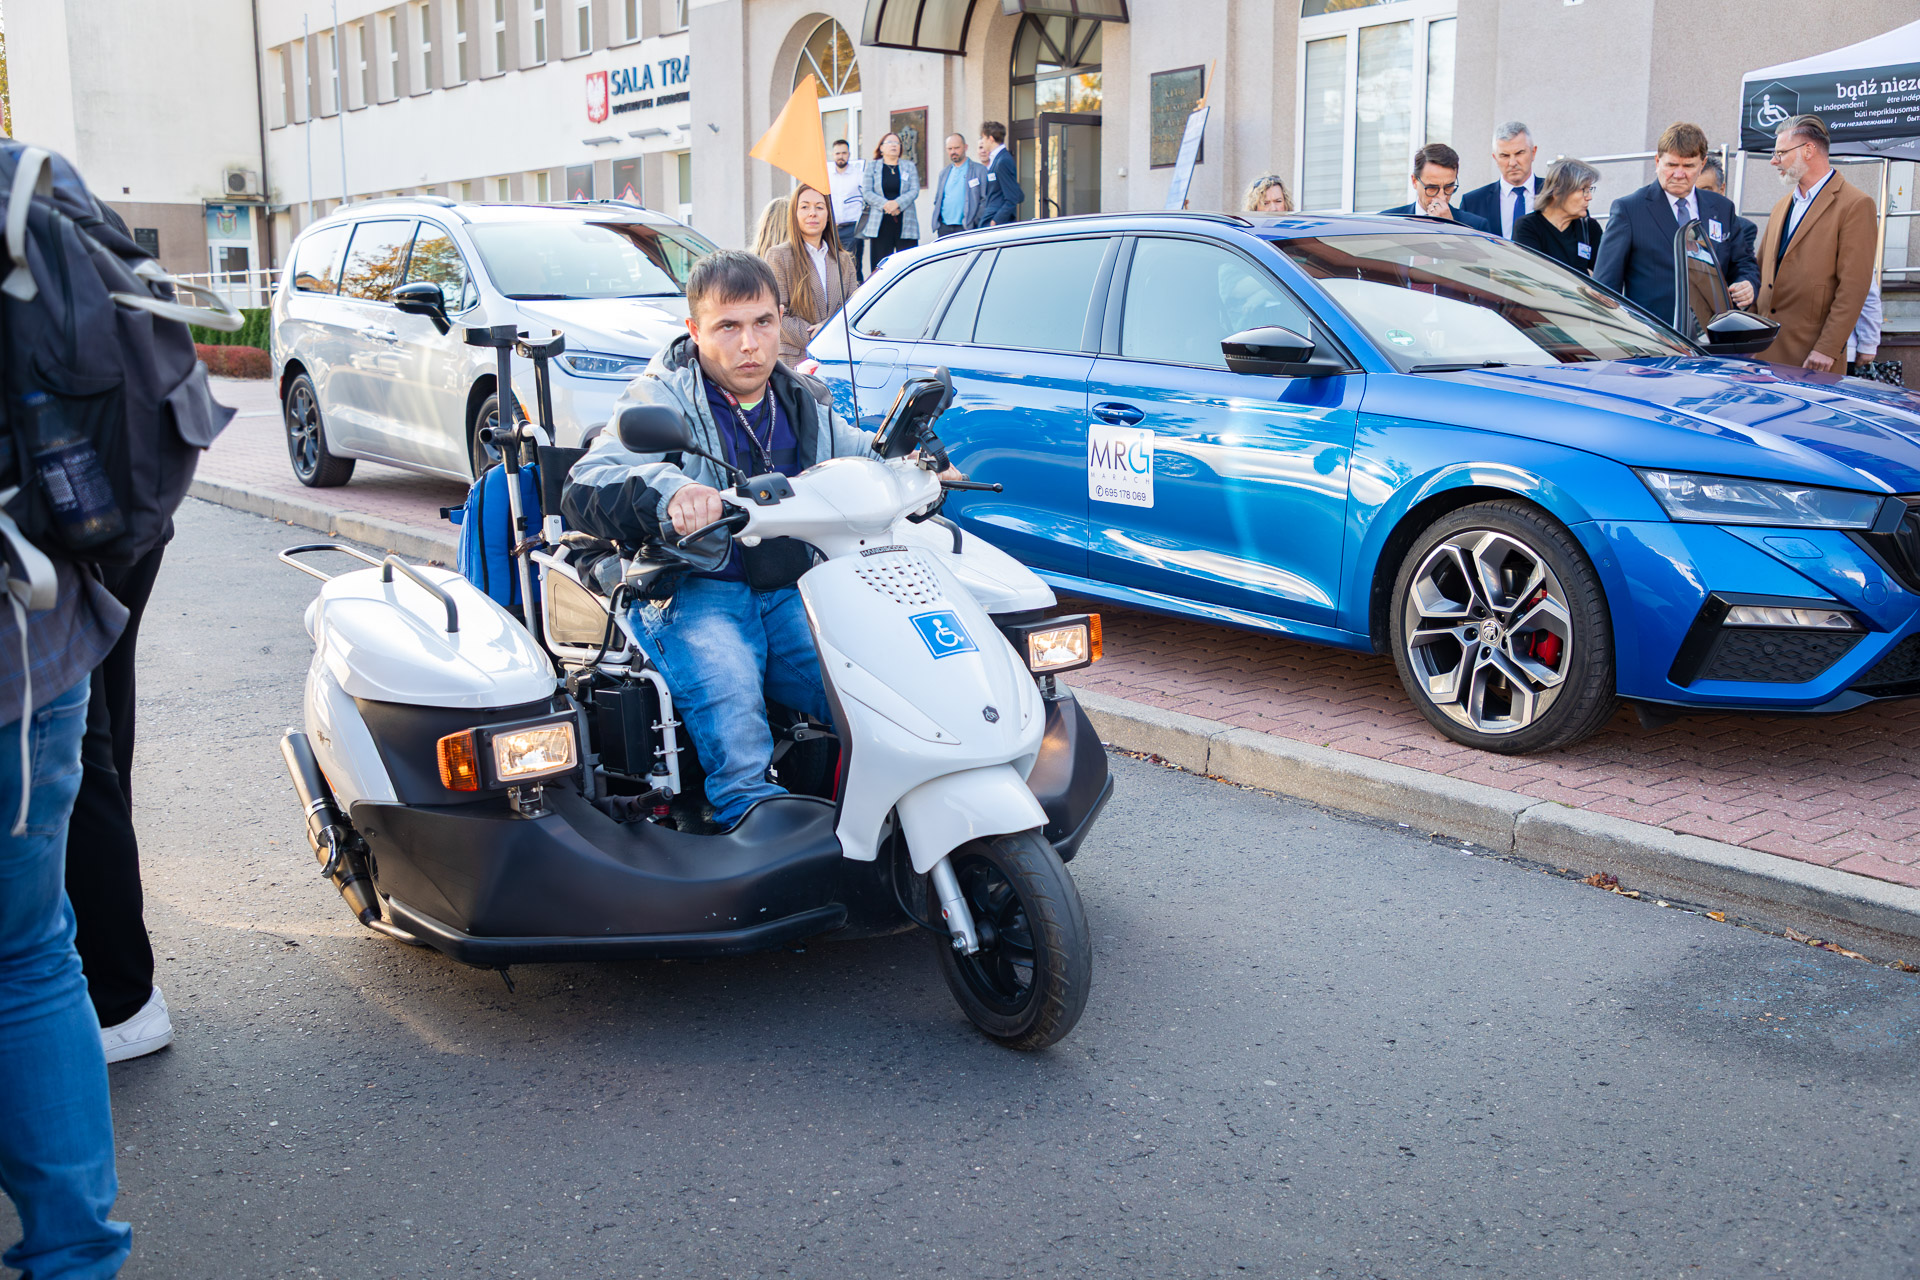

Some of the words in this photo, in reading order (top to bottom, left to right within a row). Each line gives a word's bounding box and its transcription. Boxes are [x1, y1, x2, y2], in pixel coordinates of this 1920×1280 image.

[611, 64, 654, 96] SALA
[1836, 78, 1877, 100] bądź
[1823, 101, 1864, 111] independent
[1091, 472, 1150, 484] MARACH
[1105, 487, 1118, 498] 695
[1119, 489, 1131, 500] 178
[1132, 491, 1147, 502] 069
